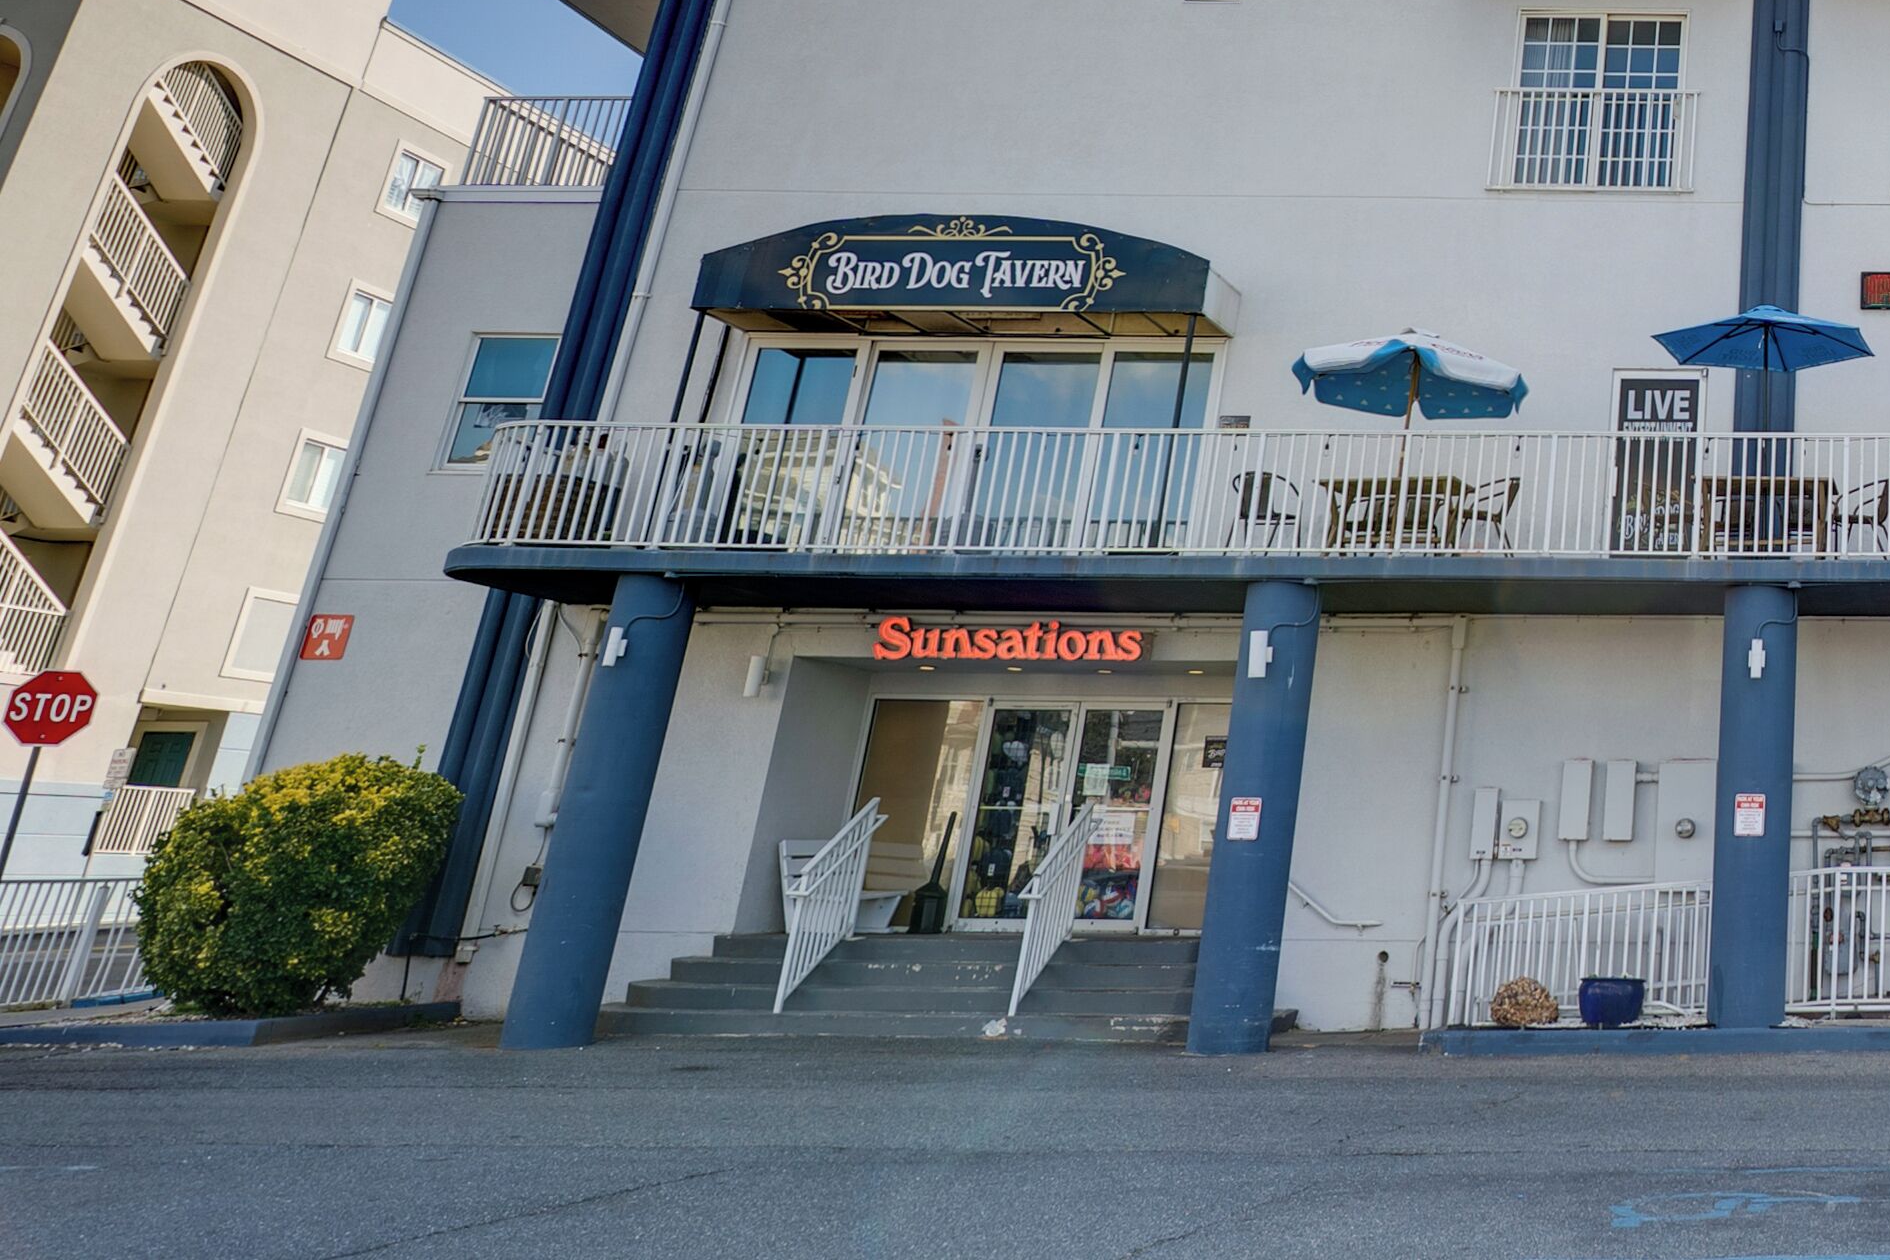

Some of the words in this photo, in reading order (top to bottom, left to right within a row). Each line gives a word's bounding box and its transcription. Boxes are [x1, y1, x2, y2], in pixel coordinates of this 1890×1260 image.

[826, 251, 900, 294] BIRD
[902, 251, 973, 290] DOG
[975, 251, 1087, 298] TAVERN
[1626, 389, 1692, 420] LIVE
[873, 616, 1143, 661] Sunsations
[9, 692, 93, 723] STOP
